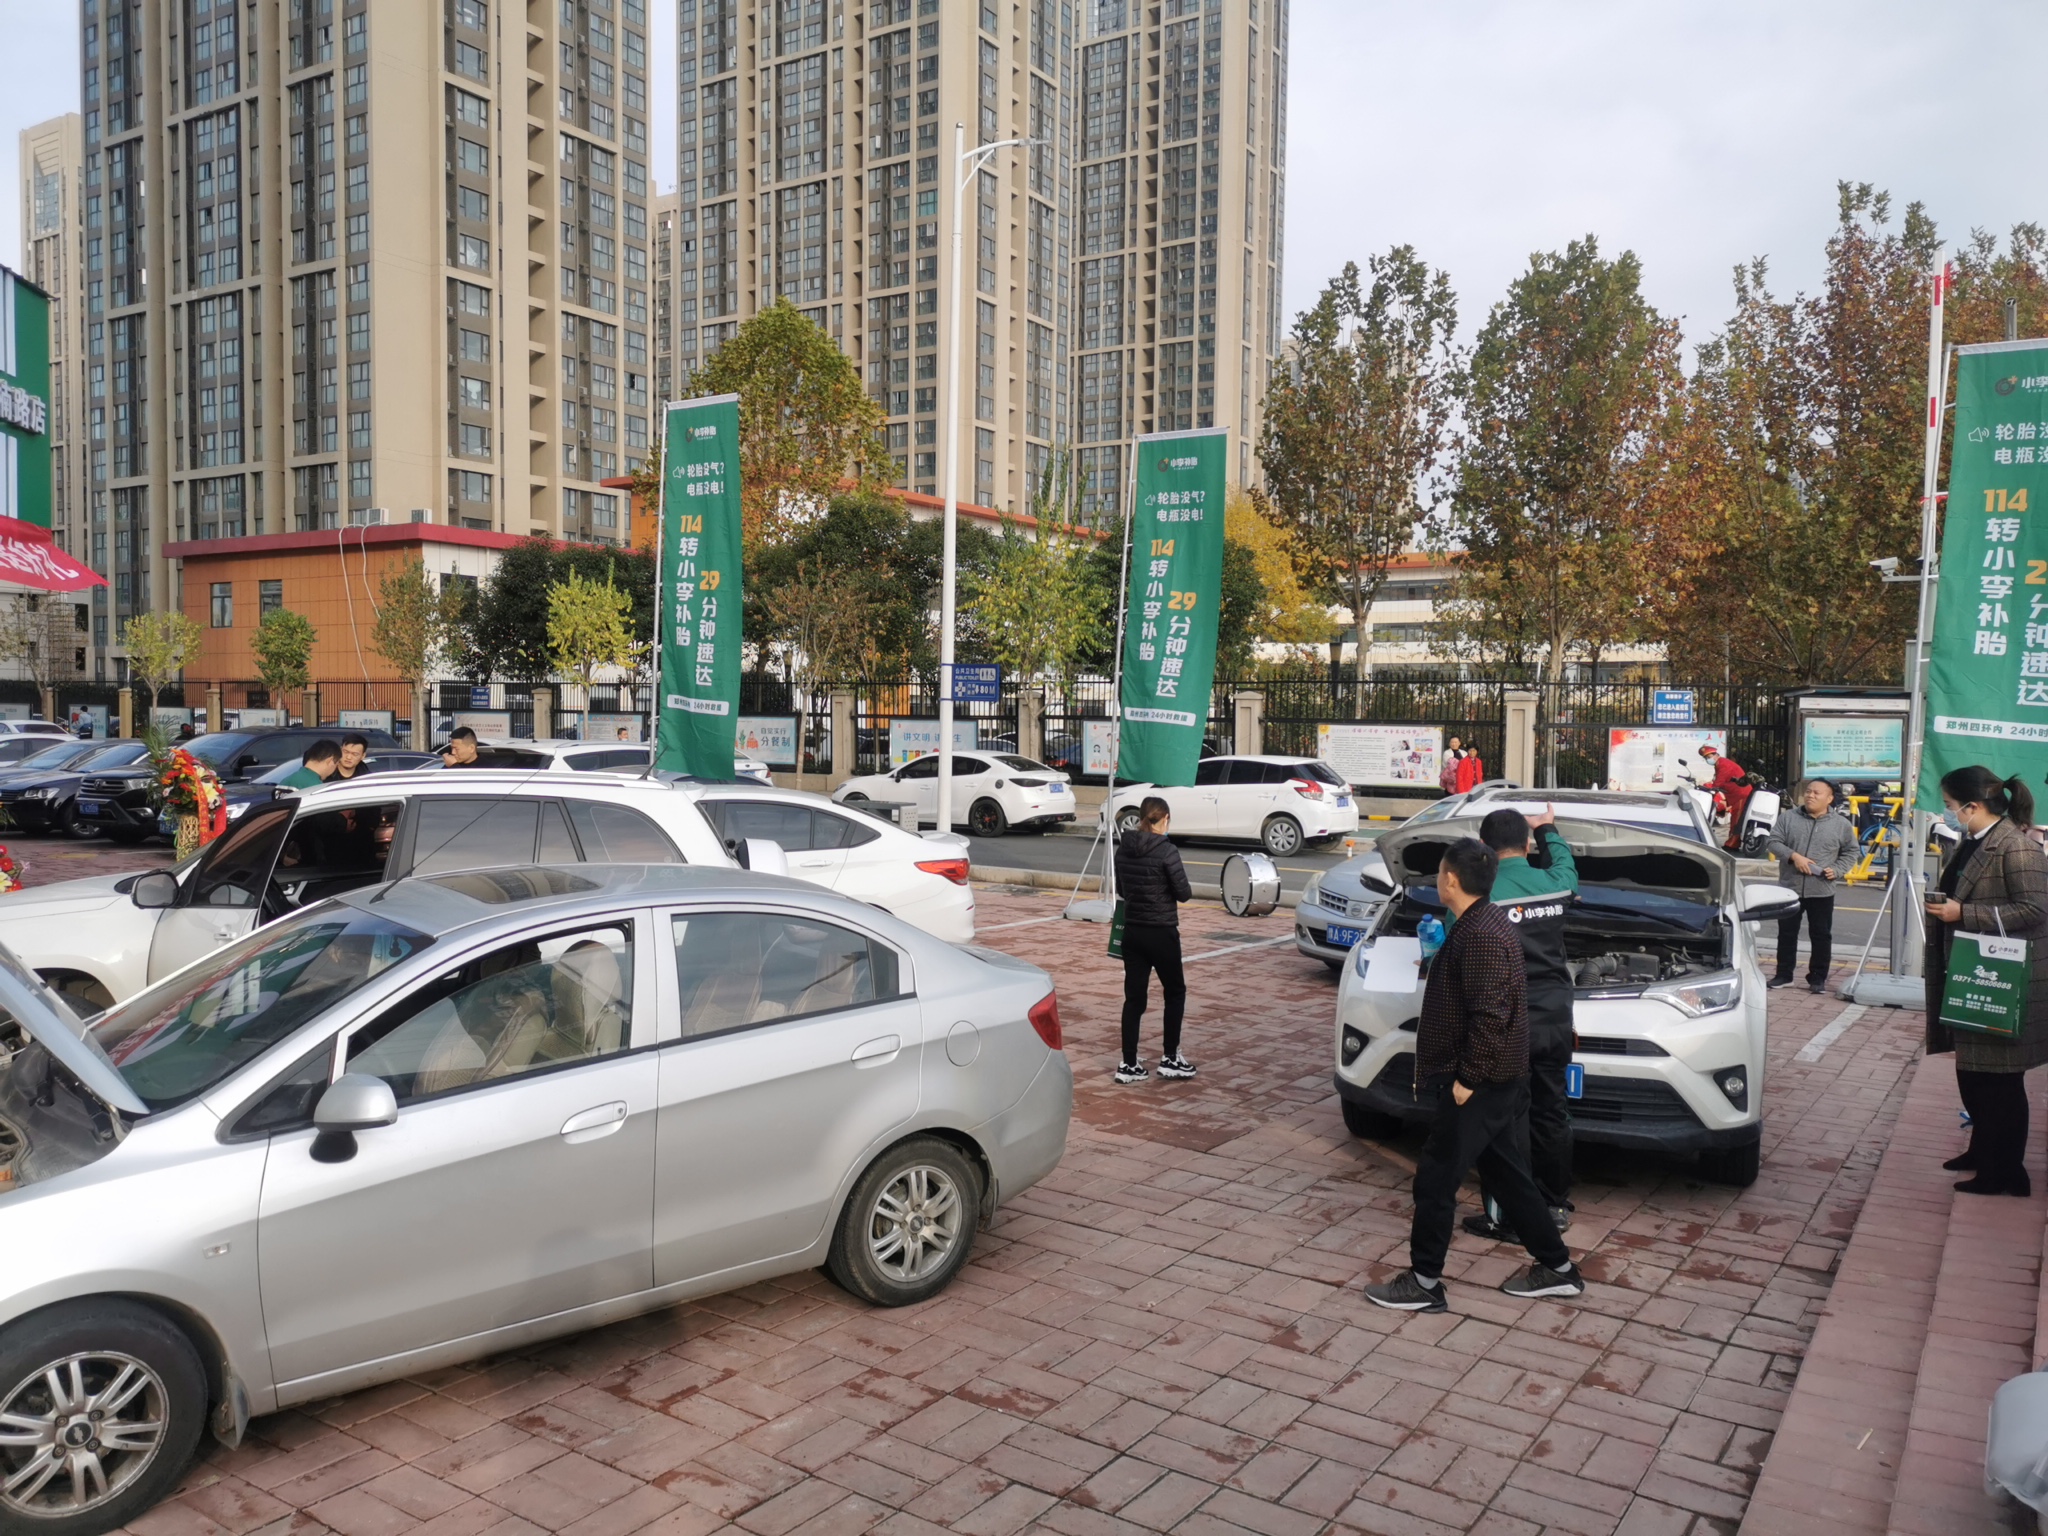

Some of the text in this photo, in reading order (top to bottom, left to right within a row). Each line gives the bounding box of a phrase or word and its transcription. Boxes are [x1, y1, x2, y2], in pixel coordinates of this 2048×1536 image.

[1946, 721, 2003, 734] 郑州四环内
[761, 736, 790, 747] 分餐制
[904, 733, 961, 742] 讲文明 讲生
